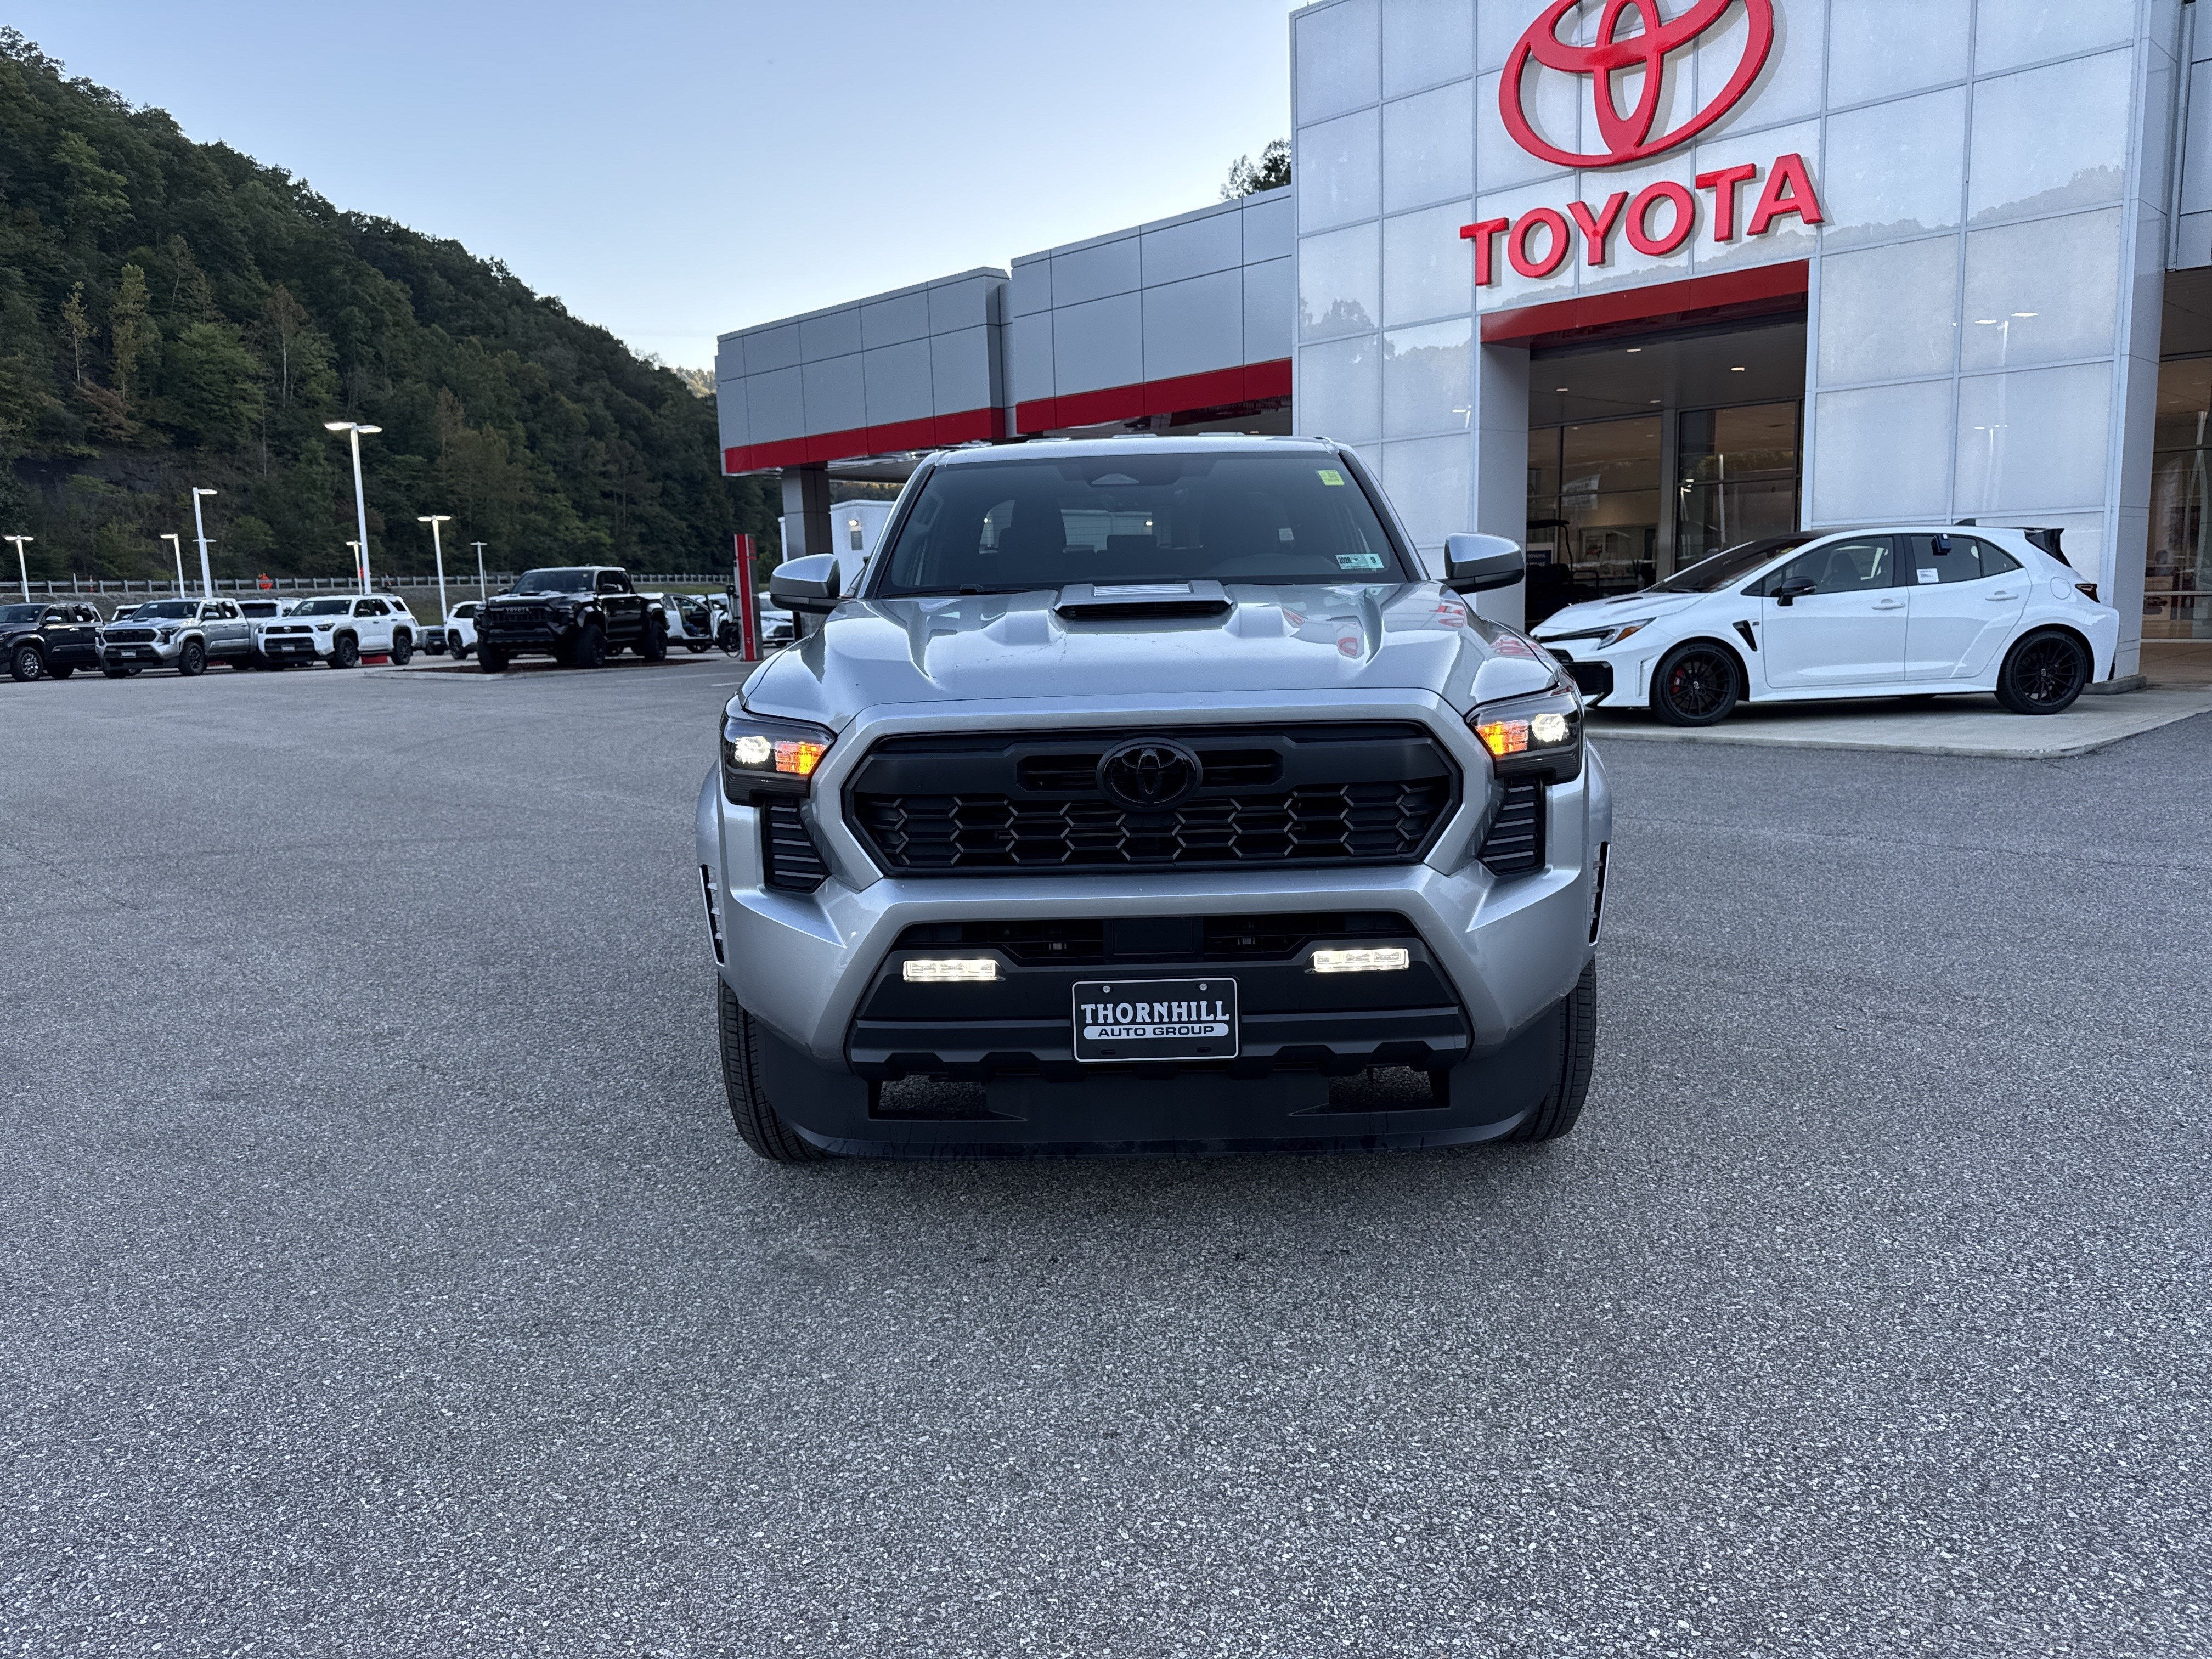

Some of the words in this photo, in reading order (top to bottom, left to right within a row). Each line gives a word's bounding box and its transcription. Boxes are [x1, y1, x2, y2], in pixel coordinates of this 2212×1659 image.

[1460, 153, 1825, 286] TOYOTA
[1081, 1001, 1229, 1024] THORNHILL
[1098, 1027, 1146, 1037] AUTO
[1153, 1025, 1214, 1036] GROUP
